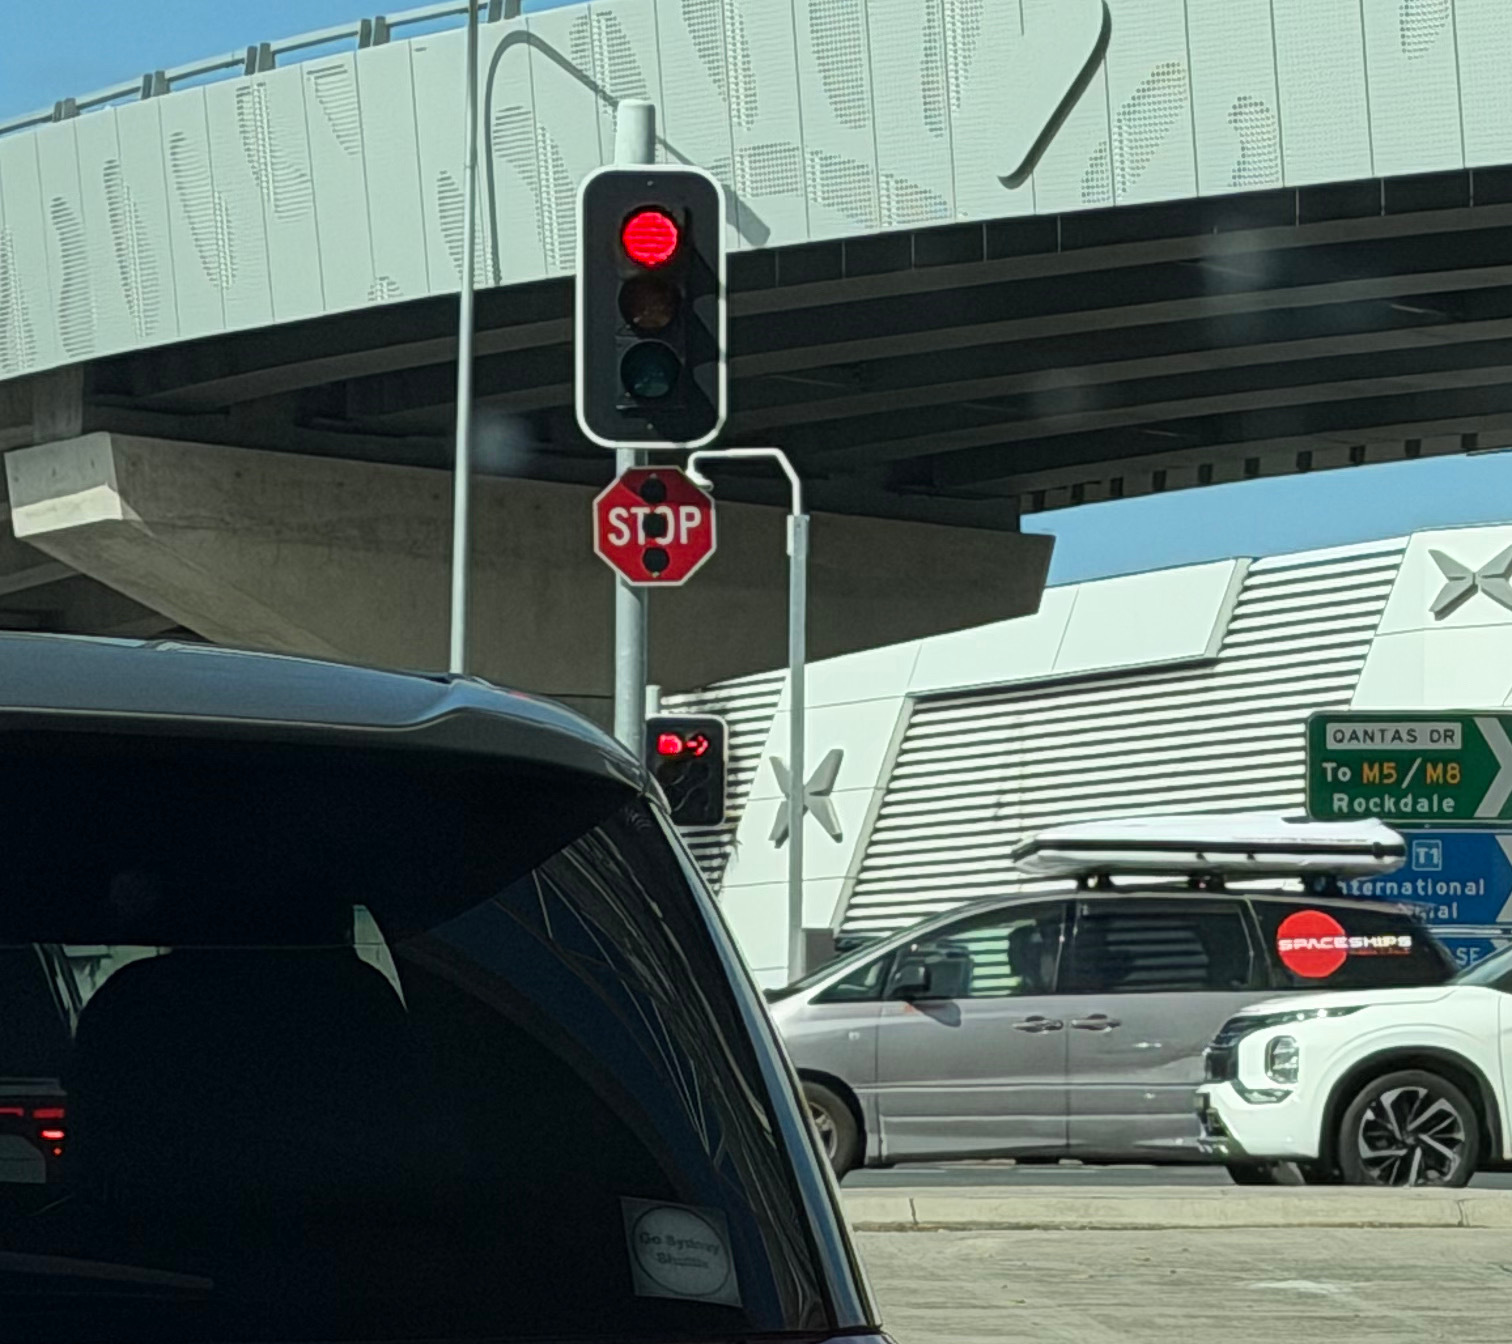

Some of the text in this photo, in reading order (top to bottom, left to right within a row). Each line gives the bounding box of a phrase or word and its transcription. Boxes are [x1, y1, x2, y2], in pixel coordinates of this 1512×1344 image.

[607, 505, 703, 547] STOP
[1332, 728, 1456, 744] QANTAS DR
[1322, 762, 1352, 782] To
[1332, 793, 1455, 813] Rockdale
[1415, 847, 1440, 865] T1
[1337, 877, 1485, 897] nternational
[1278, 935, 1413, 952] SPACESHIPS
